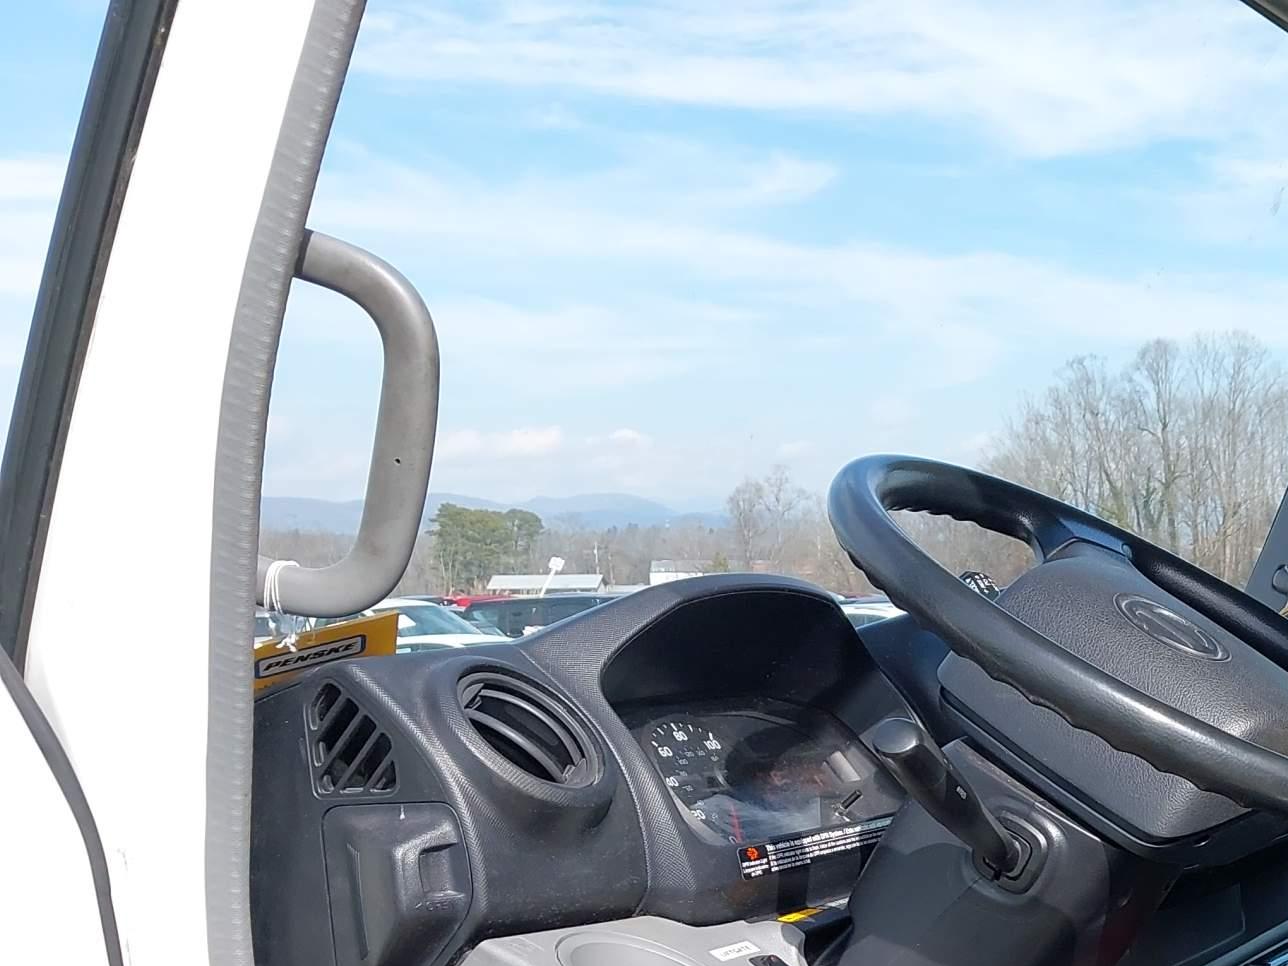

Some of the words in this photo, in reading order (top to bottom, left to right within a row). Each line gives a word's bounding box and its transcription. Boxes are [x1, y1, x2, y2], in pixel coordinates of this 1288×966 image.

[263, 641, 358, 672] PENSKE
[672, 731, 688, 741] 80
[703, 739, 721, 750] 100
[658, 746, 673, 758] 60
